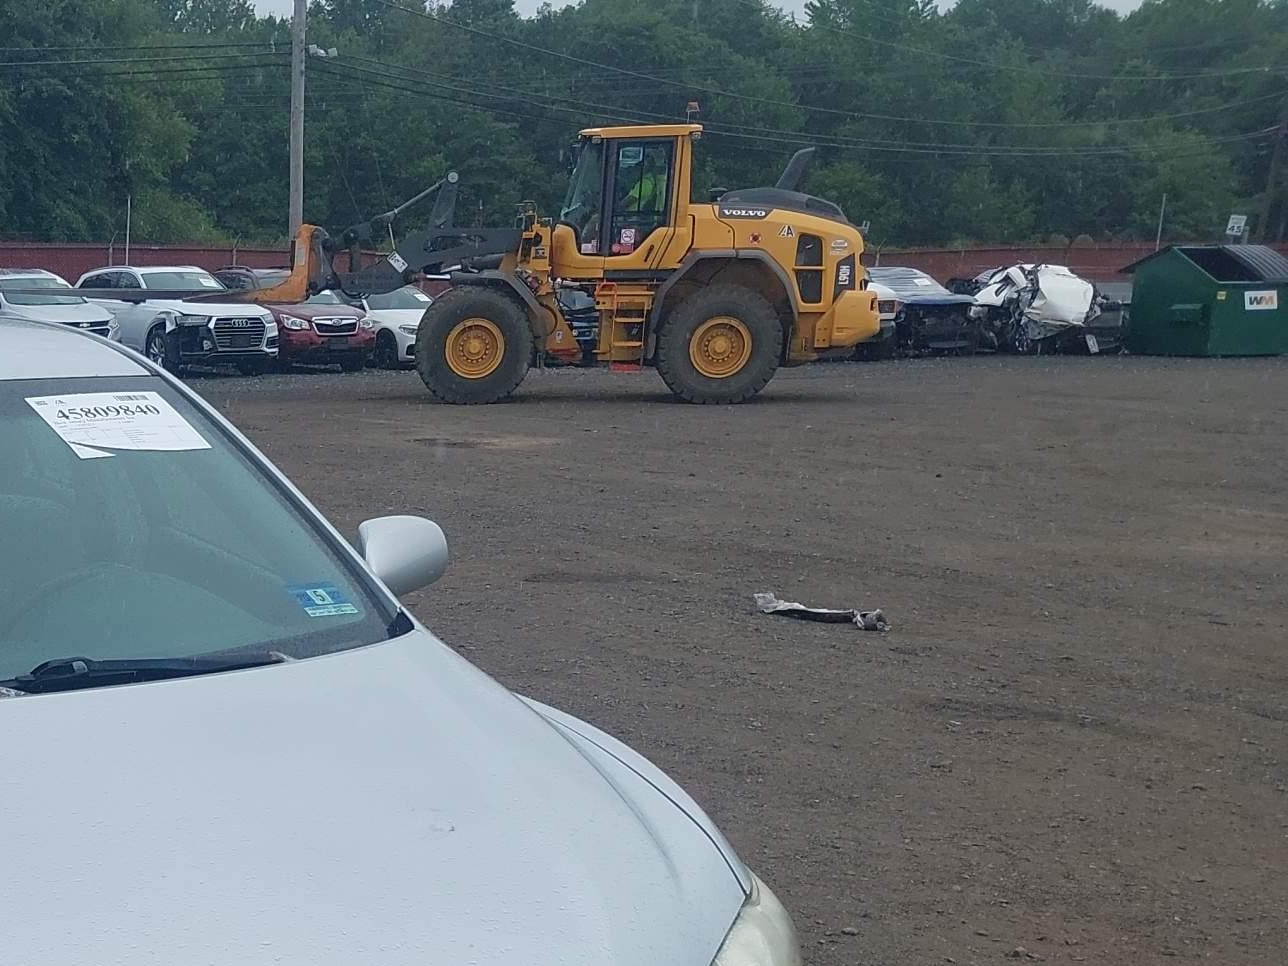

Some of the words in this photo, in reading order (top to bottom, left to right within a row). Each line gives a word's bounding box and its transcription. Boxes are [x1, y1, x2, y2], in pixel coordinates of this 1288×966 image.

[722, 208, 766, 217] VOLVO
[1228, 225, 1242, 233] 45
[838, 265, 851, 285] L90H
[1248, 295, 1274, 306] WM
[56, 404, 161, 420] 45809840
[312, 590, 326, 602] 5
